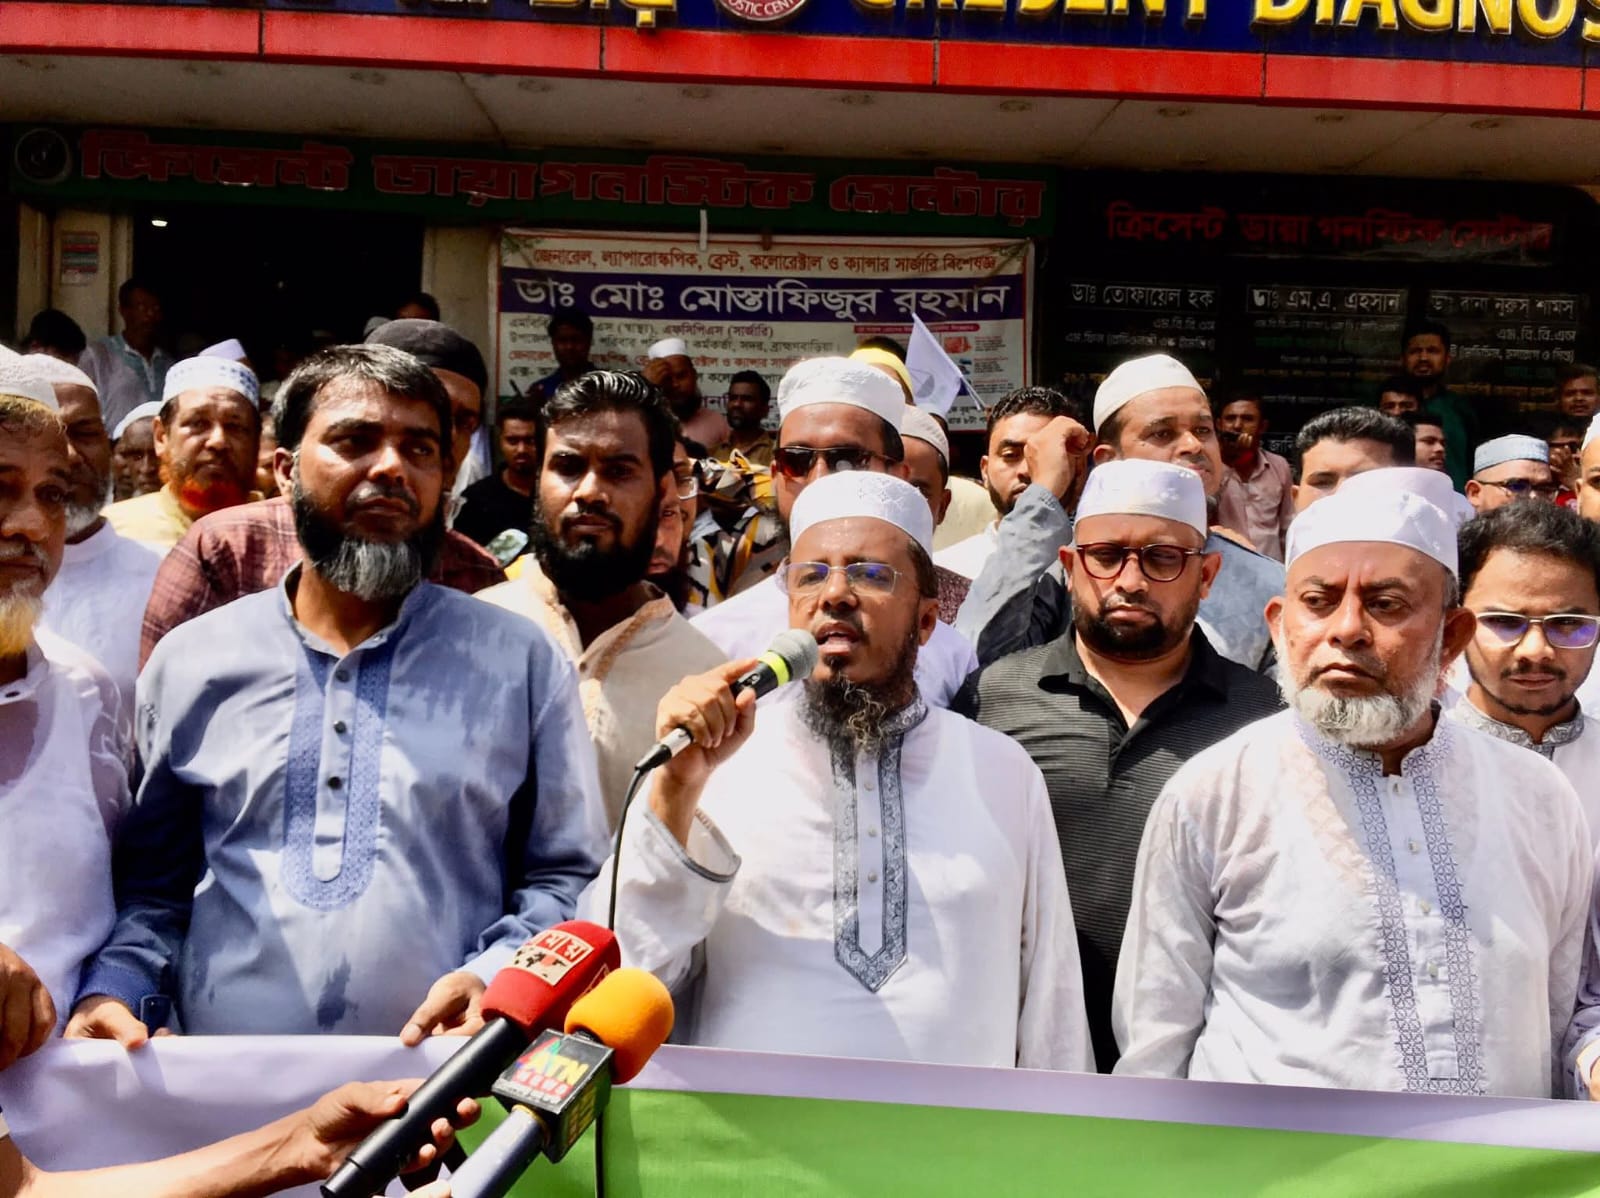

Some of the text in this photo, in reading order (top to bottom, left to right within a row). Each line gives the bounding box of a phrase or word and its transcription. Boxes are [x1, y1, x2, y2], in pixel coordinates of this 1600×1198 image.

[82, 130, 355, 191] ক্রিসেন্ট
[829, 166, 1046, 227] সেন্টার
[1106, 199, 1227, 242] ক্রিসেন্ট
[533, 248, 597, 267] জেনারেল,
[708, 250, 744, 271] ব্রেস্ট,
[828, 256, 840, 271] ও
[895, 251, 940, 273] সার্জারি
[943, 252, 997, 272] বিশেষজ্ঞ
[513, 276, 1010, 321] ডাঃ মোঃ মোস্তাফিজুর রহমান
[1070, 282, 1216, 311] ডাঃ তোফায়েল হক
[1252, 288, 1280, 309] ডাঃ
[1344, 292, 1400, 312] এহসান
[524, 1042, 589, 1086] ATN
